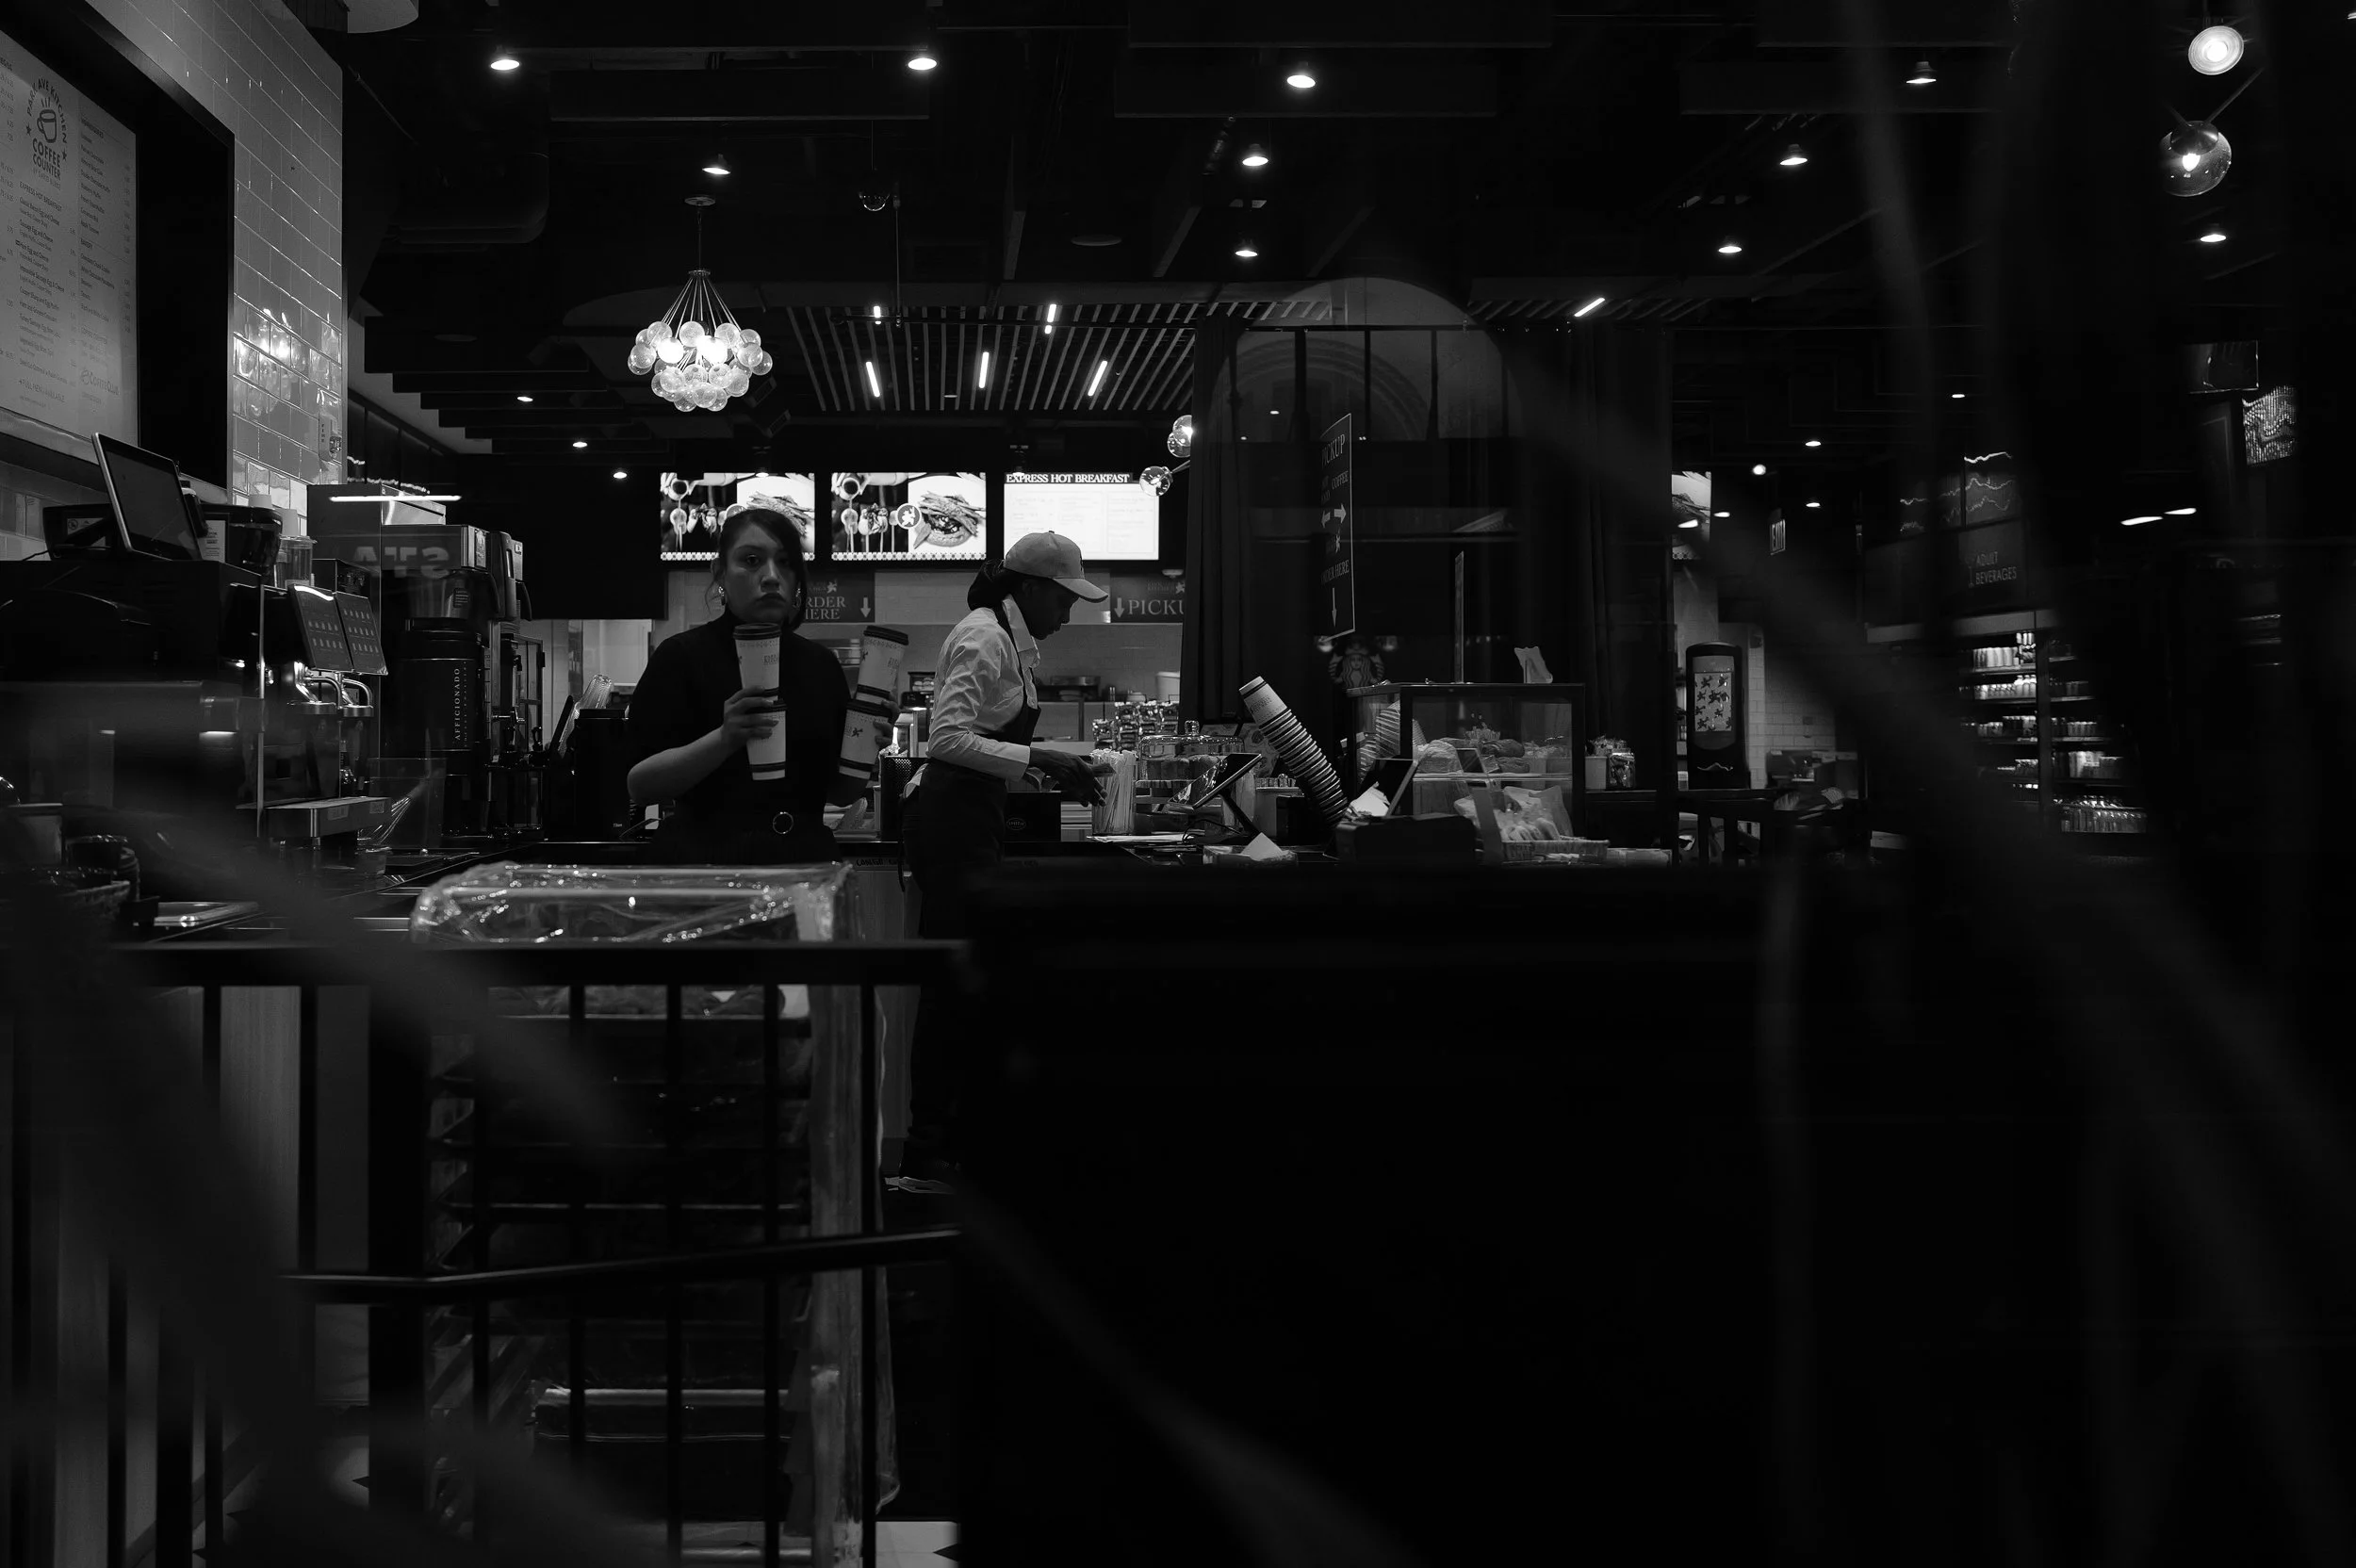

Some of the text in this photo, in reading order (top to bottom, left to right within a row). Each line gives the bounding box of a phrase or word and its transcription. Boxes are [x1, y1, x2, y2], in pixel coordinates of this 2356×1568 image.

[26, 77, 68, 144] PARK AVE KITCHEN
[32, 138, 61, 170] COFFEE
[32, 153, 61, 182] COUNTER
[1006, 473, 1130, 483] EXPRESS HOT BREAKFAST
[1331, 470, 1349, 491] COFFEE
[1335, 560, 1350, 579] HERE
[1975, 566, 2017, 585] BEVERAGES
[807, 596, 846, 608] RDER
